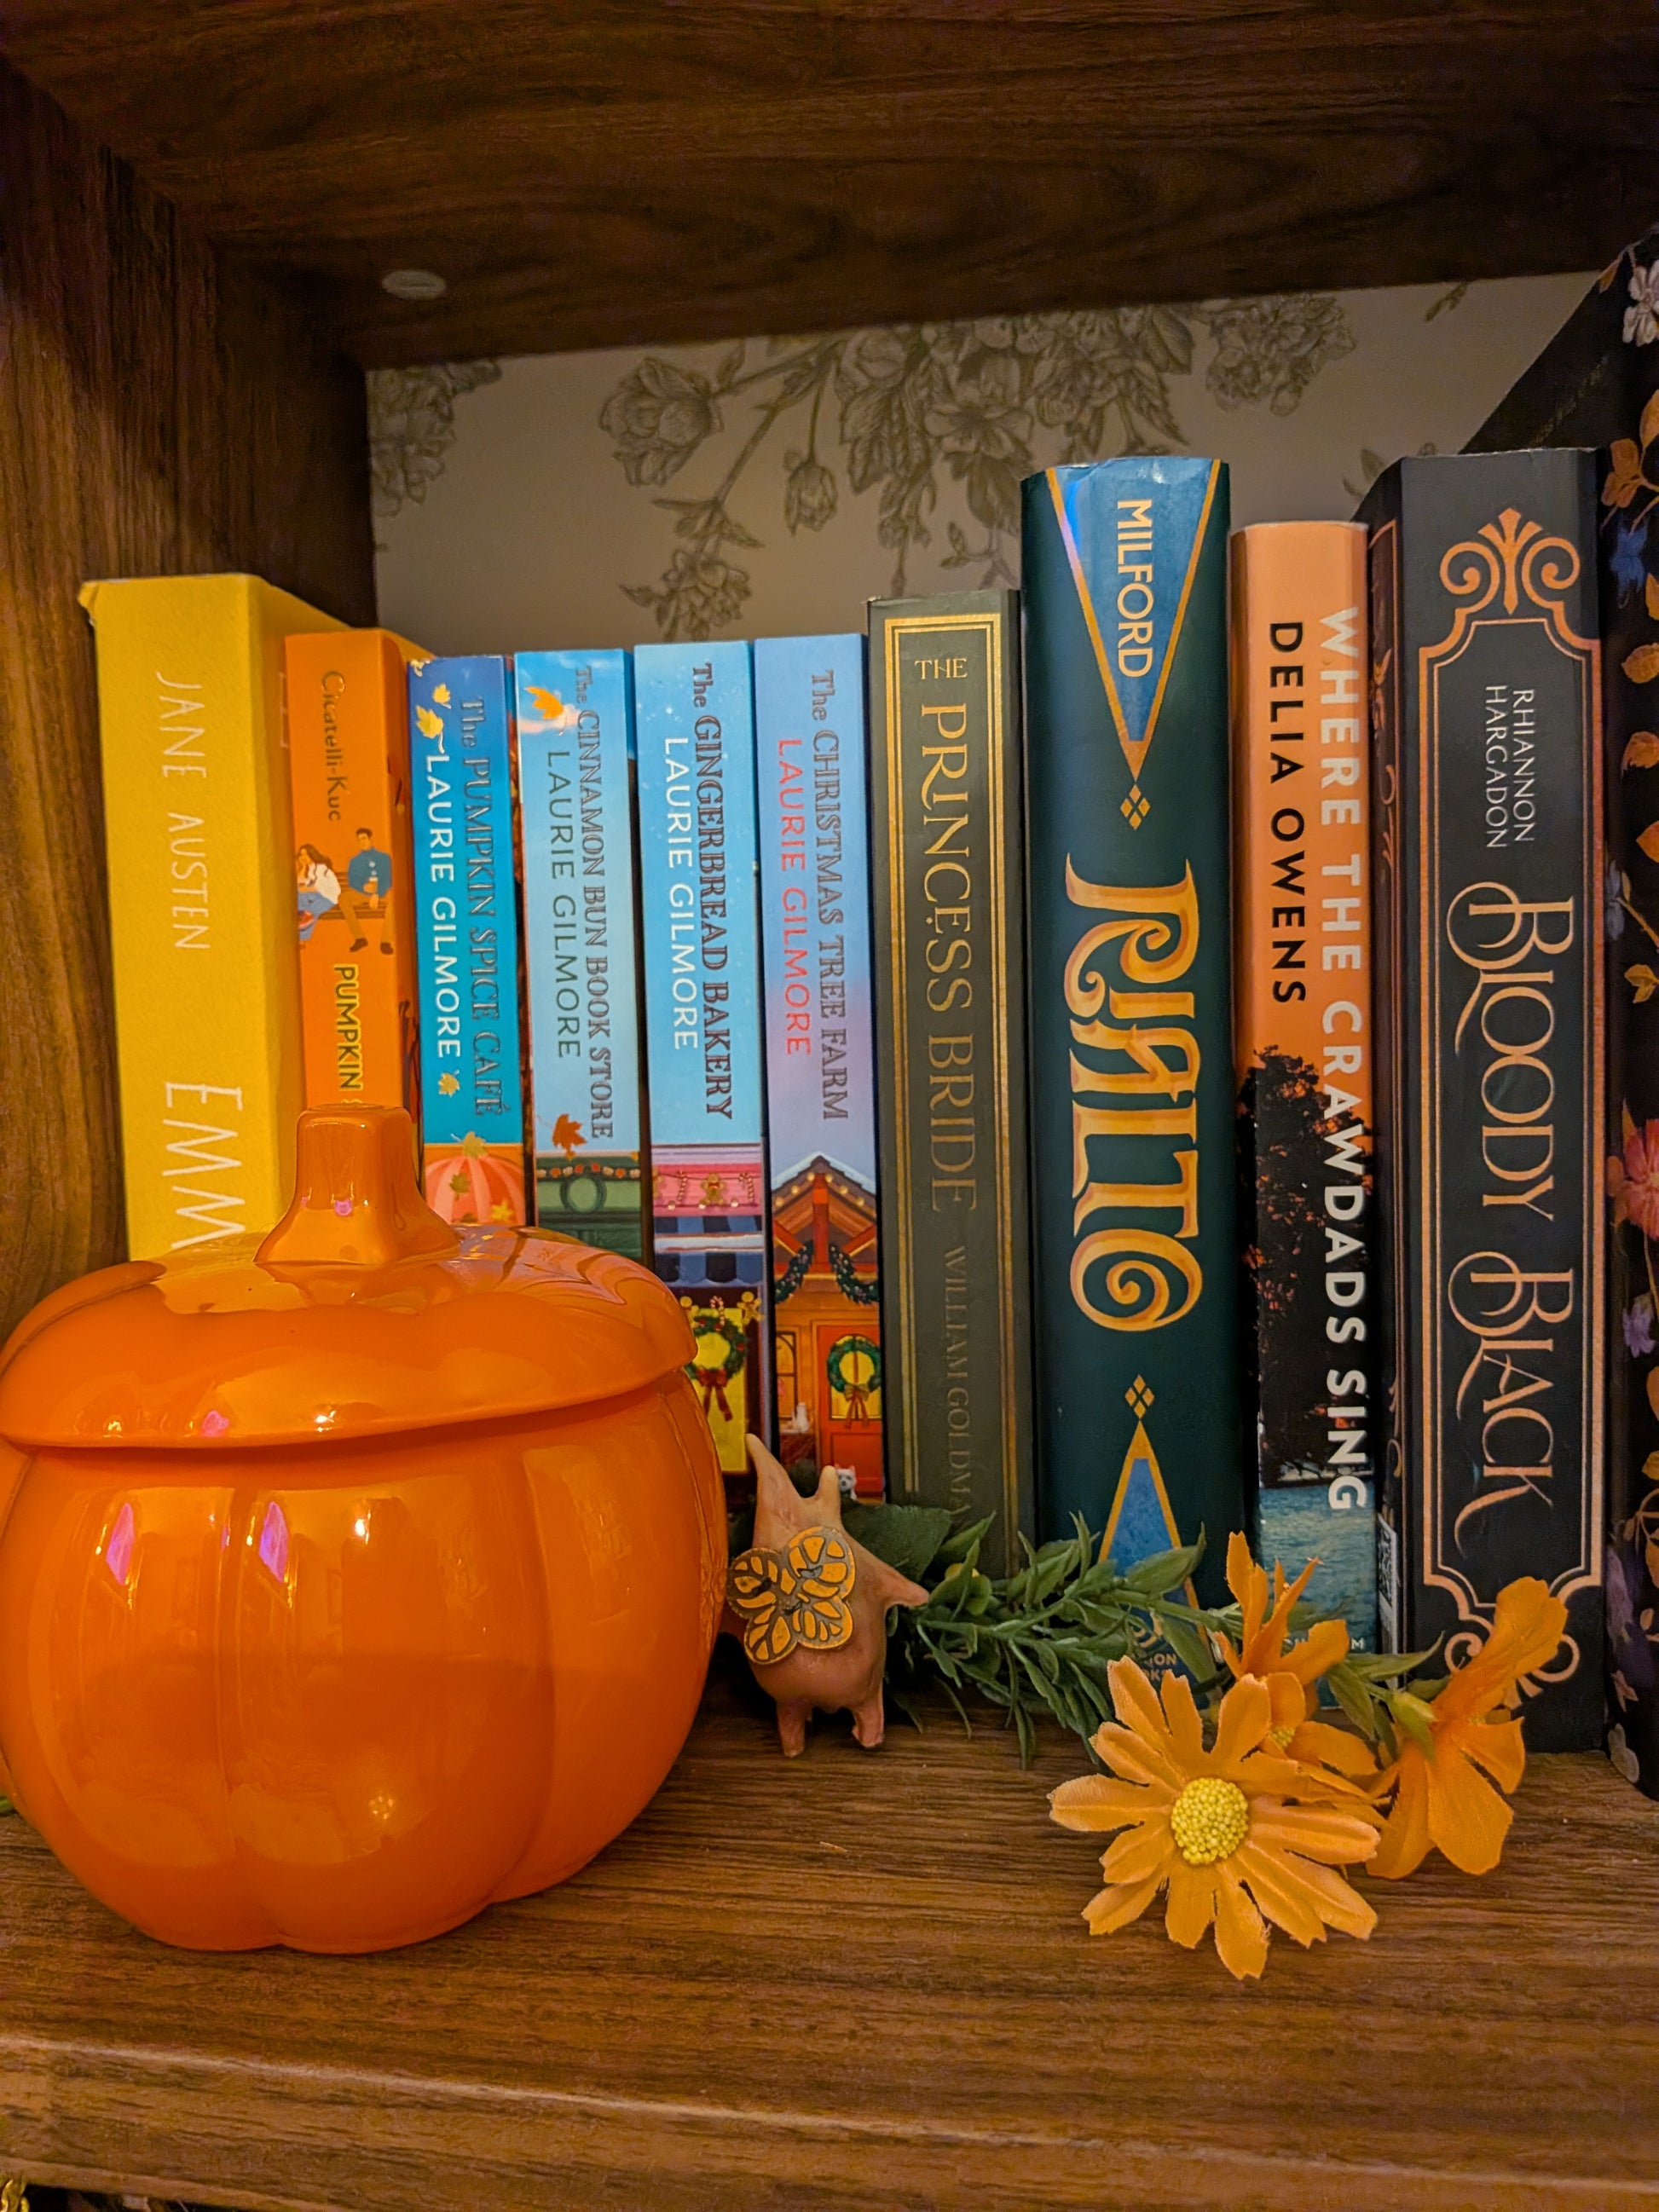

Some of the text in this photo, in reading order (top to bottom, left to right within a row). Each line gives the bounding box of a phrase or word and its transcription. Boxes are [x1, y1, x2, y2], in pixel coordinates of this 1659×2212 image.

[915, 658, 968, 680] THE
[1117, 499, 1155, 678] MILFORD
[156, 670, 211, 950] JANE AUSTEN
[321, 670, 348, 821] Cicatelli-Kuc
[663, 737, 699, 1050] LAURIE GILMORE
[691, 661, 734, 1120] The GINGERBREAD BAKERY
[777, 738, 811, 1056] LAURIE GILMORE
[810, 668, 849, 1120] The CHRISTMAS TREE FARM
[1269, 621, 1307, 1004] DELIA OWENS
[1485, 684, 1508, 849] HARGADON
[1513, 689, 1535, 843] RHIANNON
[333, 964, 362, 1090] PUMPKIN
[426, 754, 461, 1060] LAURIE GILMORE
[460, 696, 510, 1116] The PUMPKIN SPICE CAFÉ
[546, 750, 581, 1060] LAURIE GILMORE
[574, 666, 614, 1140] The CINNAMON BUN BOOK STORE
[920, 703, 977, 1212] PRINCESS BRIDE
[162, 1082, 246, 1249] EMM
[1064, 852, 1203, 1331] RIALTO
[1320, 606, 1367, 1511] WHERE THE CRAWDADS SING
[944, 1245, 971, 1514] WILLIAM GOLDMA
